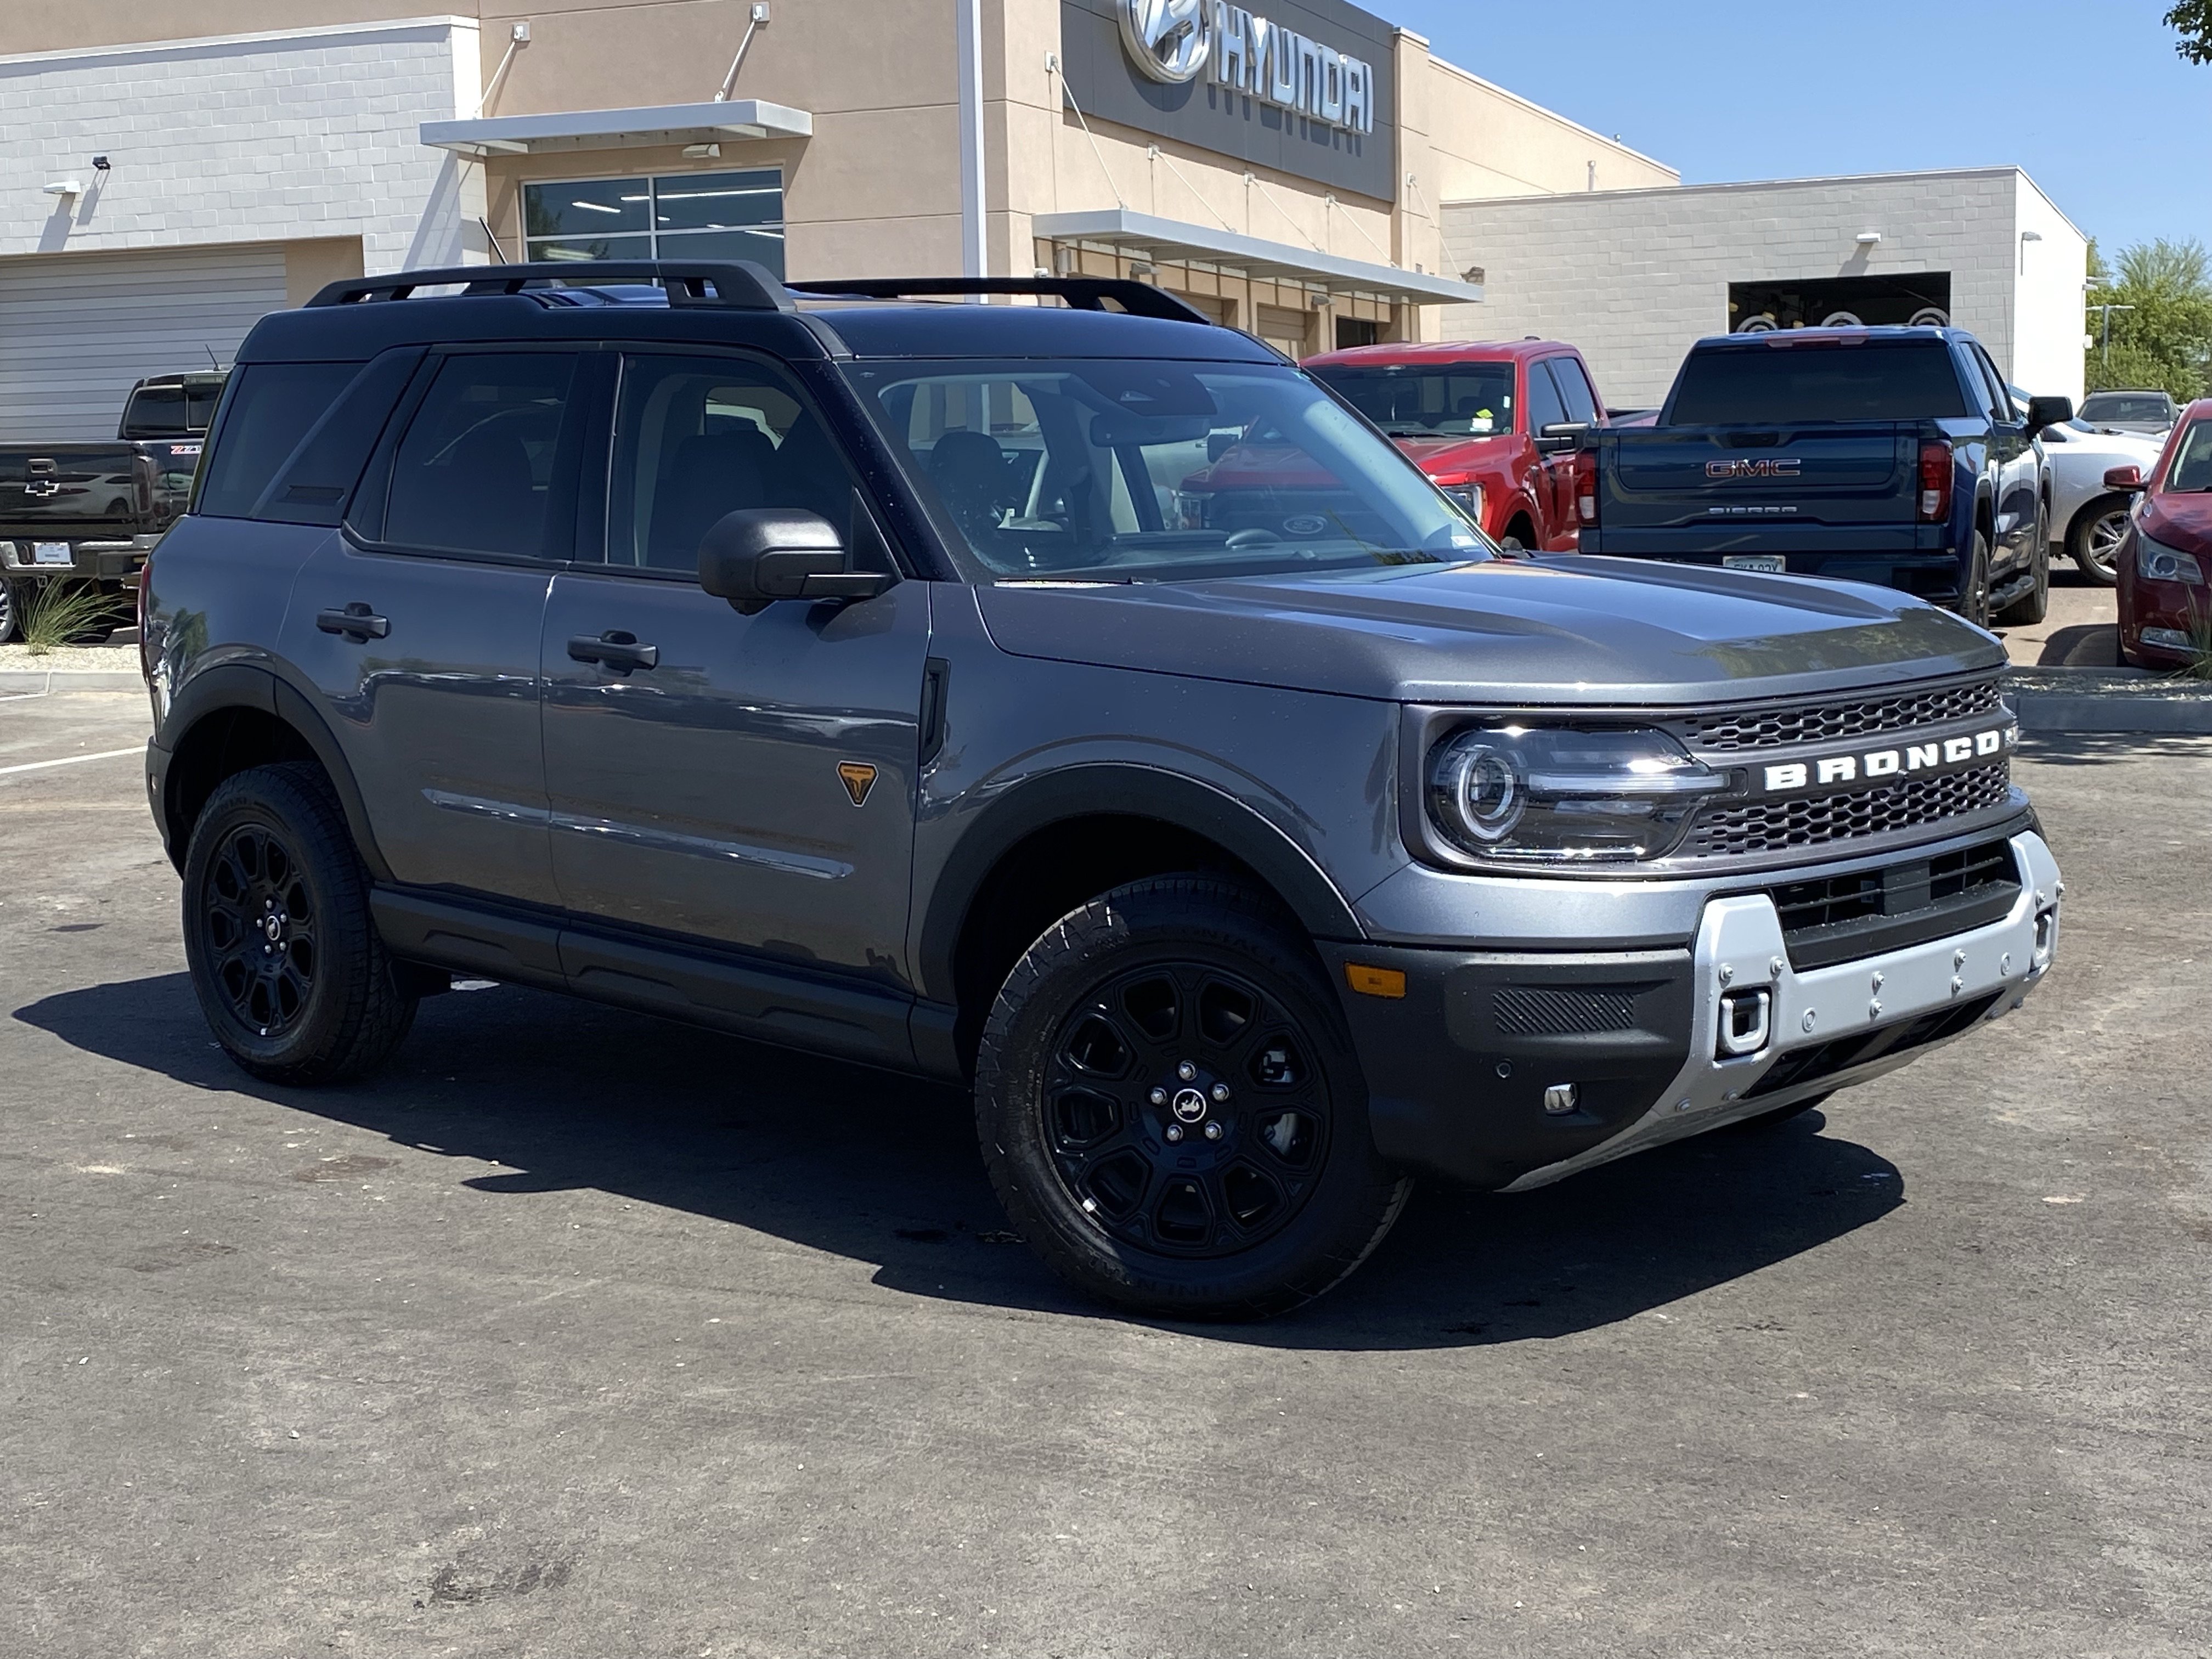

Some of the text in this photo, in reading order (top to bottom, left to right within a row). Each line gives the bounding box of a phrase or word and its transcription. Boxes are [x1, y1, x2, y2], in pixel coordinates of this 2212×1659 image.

[1210, 0, 1374, 135] HYUNDAI
[1706, 459, 1801, 478] GMC
[1764, 730, 2000, 791] BRONCO
